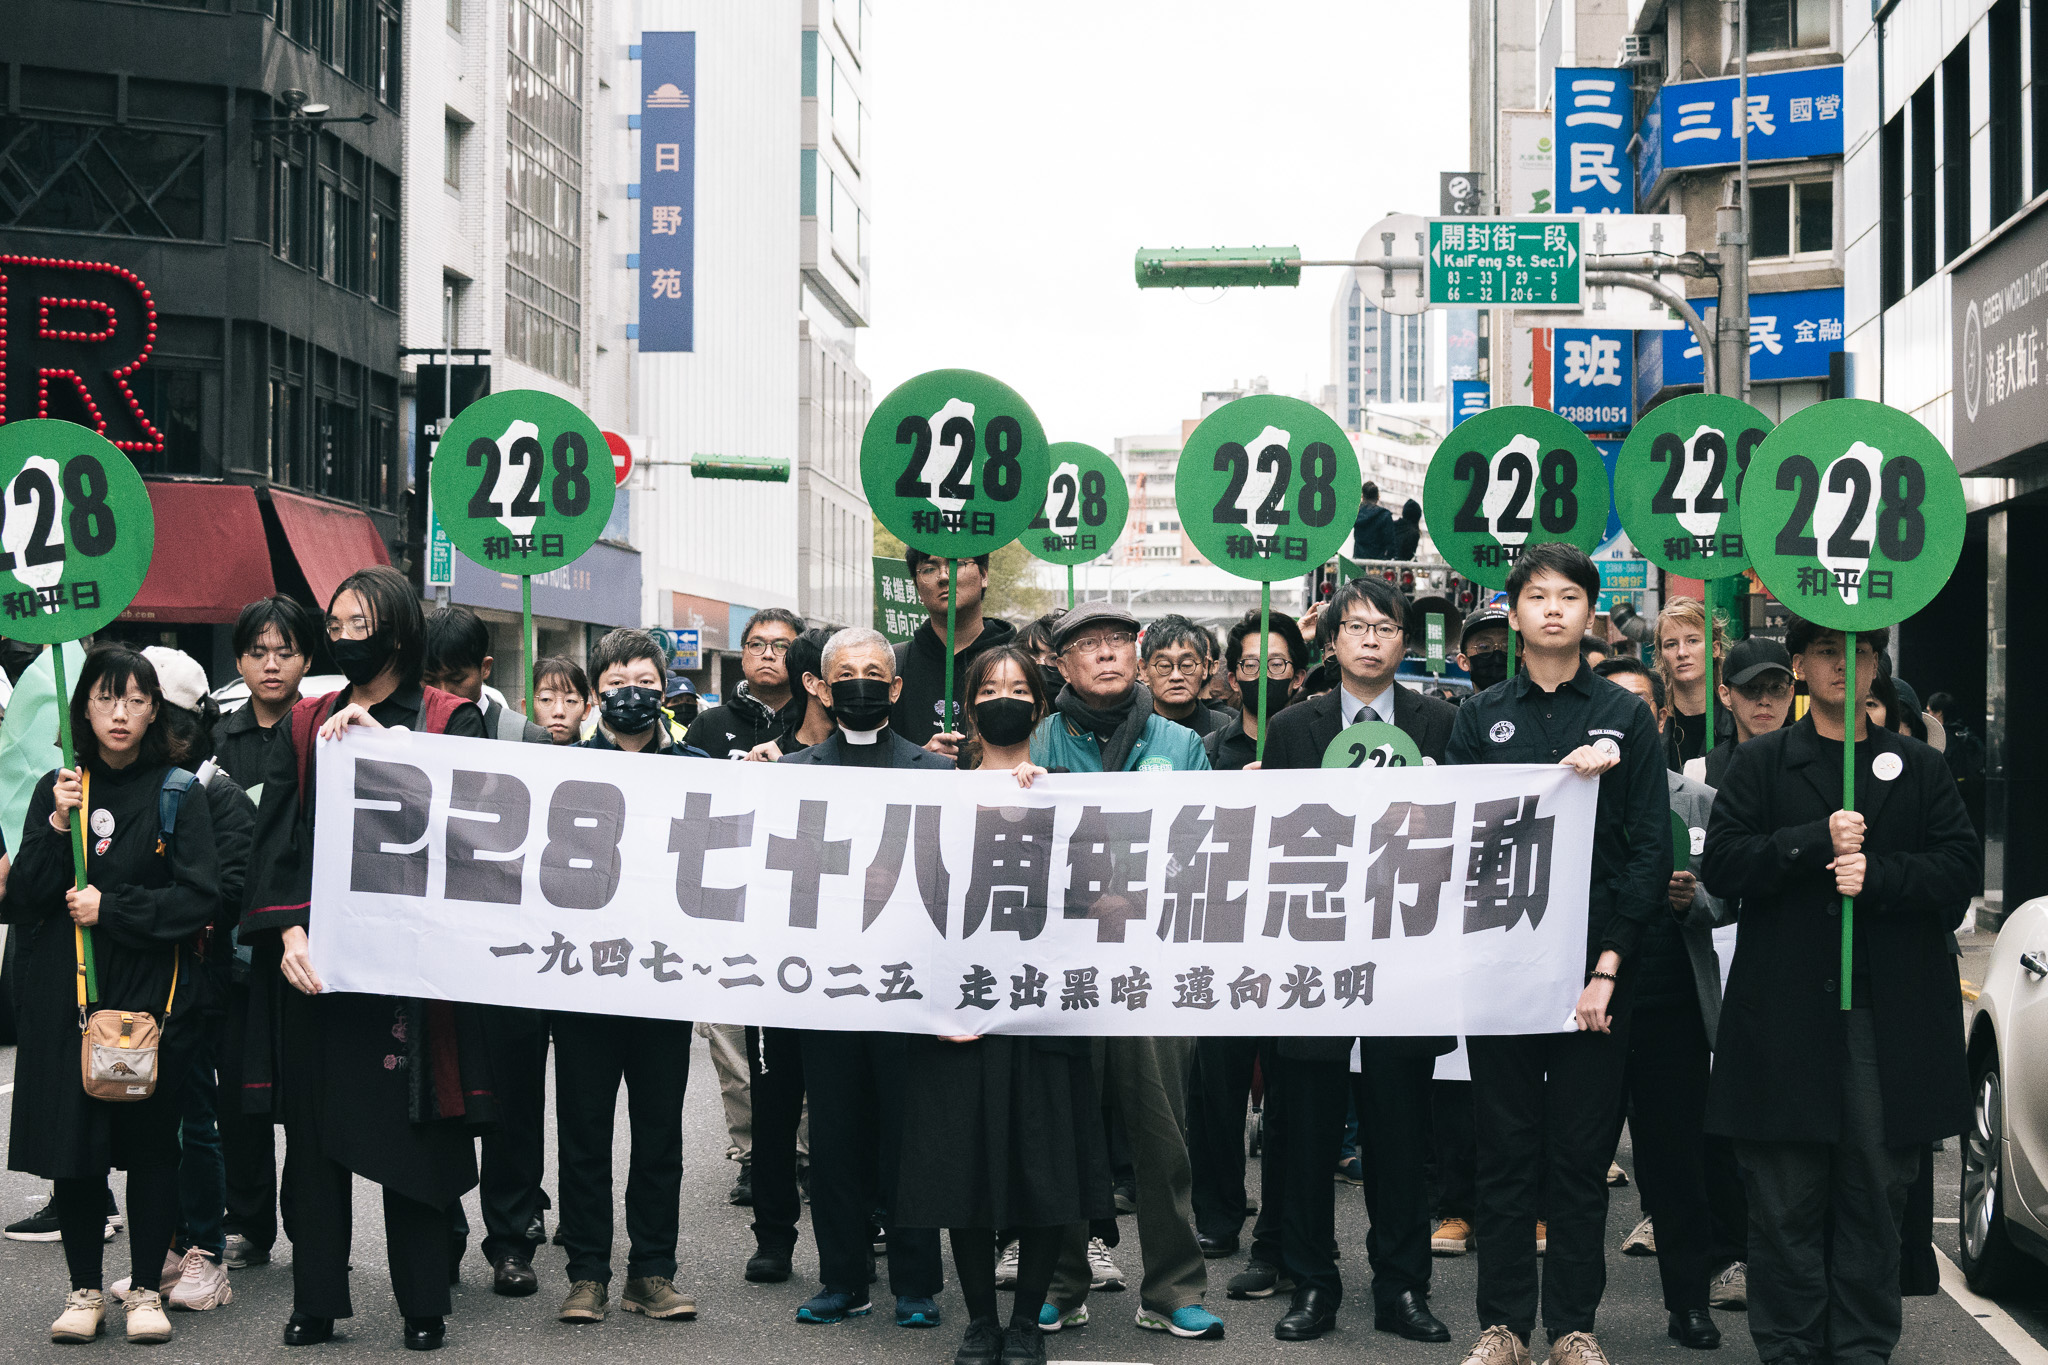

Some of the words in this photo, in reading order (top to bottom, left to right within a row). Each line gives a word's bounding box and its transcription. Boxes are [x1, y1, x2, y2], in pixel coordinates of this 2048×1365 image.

[1672, 94, 1776, 144] 三民
[1789, 94, 1843, 123] 國營
[651, 142, 683, 299] 日野苑
[1441, 224, 1567, 252] 開封街一段
[1444, 254, 1502, 271] KaiFeng
[1506, 255, 1526, 267] St.
[1530, 255, 1564, 267] Sec.1
[1447, 271, 1460, 284] 83
[1480, 271, 1493, 285] 33
[1515, 272, 1528, 285] 29
[1551, 272, 1558, 285] 5
[1447, 287, 1460, 301] 66
[1480, 287, 1493, 301] 32
[1551, 288, 1558, 301] 6
[1983, 291, 2004, 329] GREEN
[2004, 272, 2029, 314] WORLD
[1793, 317, 1844, 344] 金融
[1559, 406, 1627, 423] 23881051
[896, 416, 1022, 503] 228
[467, 432, 590, 518] 228
[1213, 442, 1337, 527] 228
[1454, 449, 1578, 534] 228
[0, 454, 117, 569] 28
[1776, 455, 1926, 561] 228
[912, 510, 996, 537] 和平日
[483, 534, 564, 561] 和平日
[1043, 534, 1097, 552] 和平日
[1226, 535, 1308, 561] 和平日
[1472, 543, 1526, 568] 和平
[1664, 534, 1744, 562] 和平日
[881, 575, 925, 606] 承繼勇
[1796, 566, 1894, 600] 和平日
[3, 580, 100, 620] 和平日
[350, 758, 626, 910] 228
[667, 792, 1556, 944] 七十八周年紀念行動
[955, 964, 1153, 1011] 走出黑暗
[1172, 962, 1377, 1011] 邁向光明
